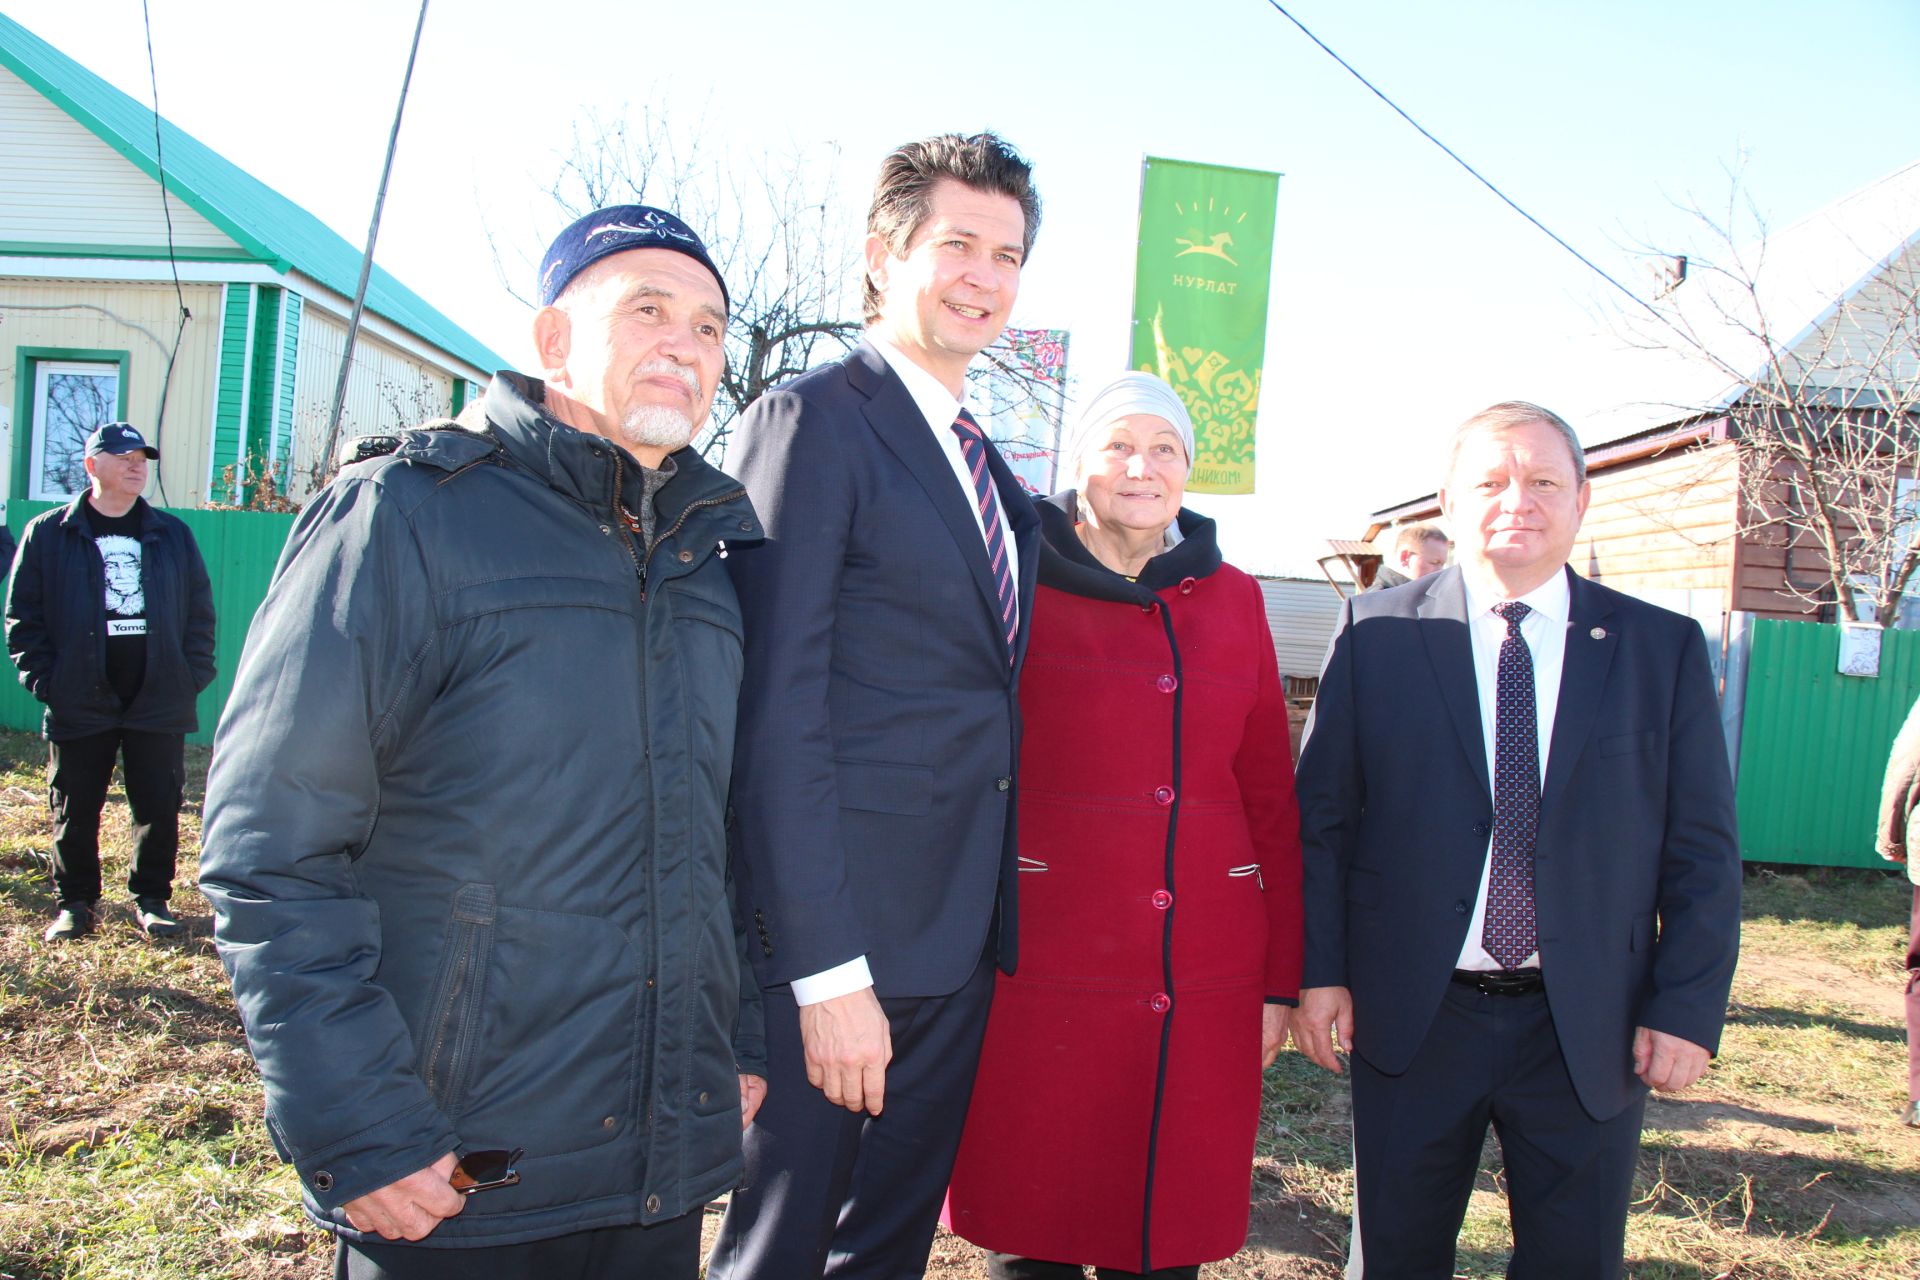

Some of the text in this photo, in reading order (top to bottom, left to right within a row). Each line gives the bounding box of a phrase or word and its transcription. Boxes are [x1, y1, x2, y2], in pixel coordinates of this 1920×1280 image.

[1173, 274, 1237, 295] НУРЛАТ
[1188, 467, 1241, 485] ДНИКОМ!
[113, 623, 146, 632] Yama
